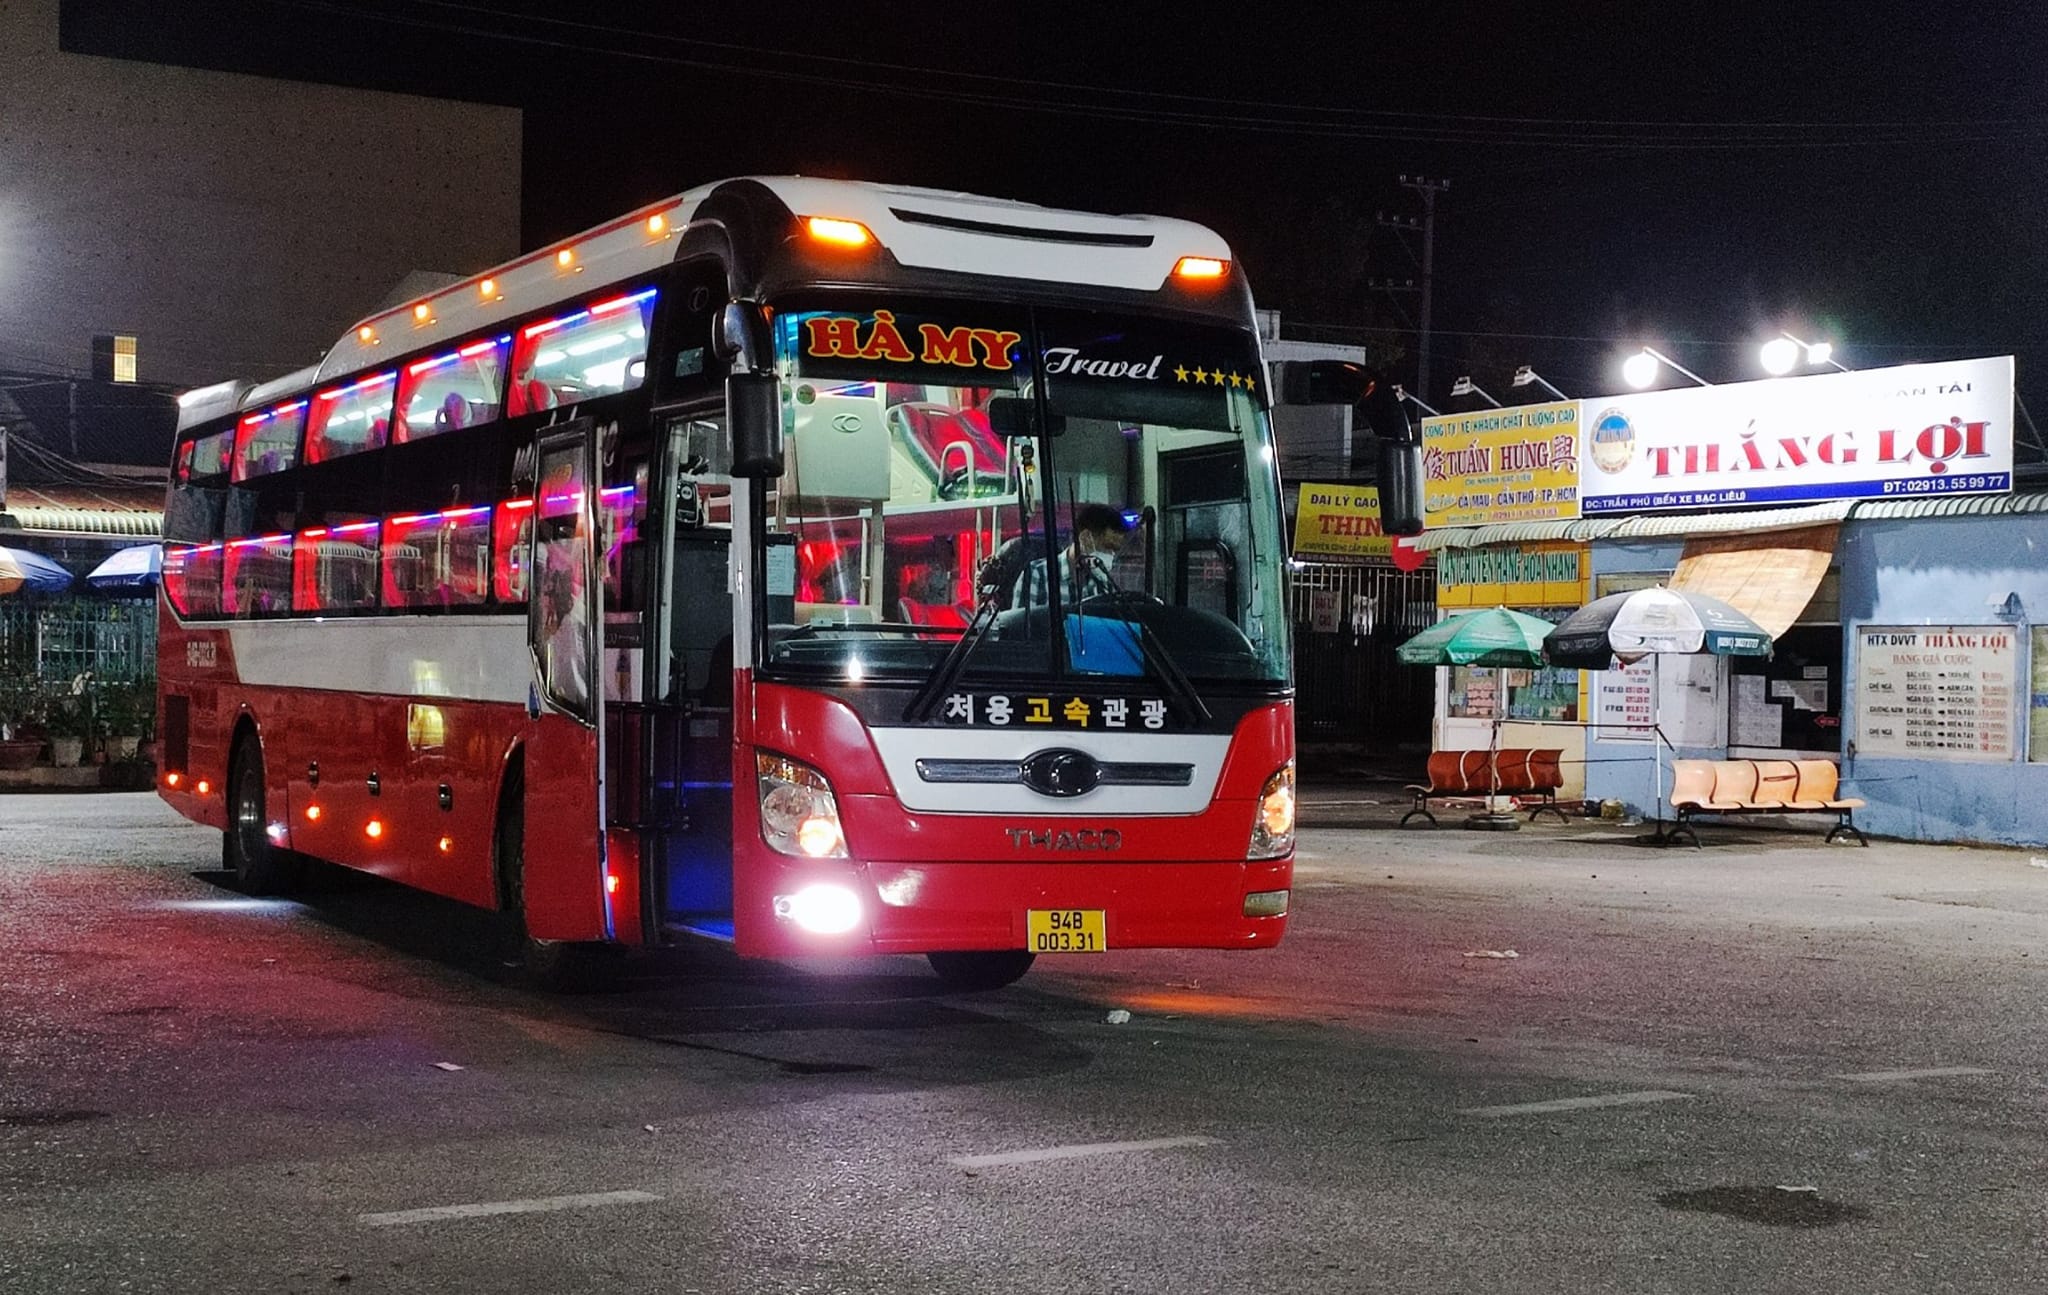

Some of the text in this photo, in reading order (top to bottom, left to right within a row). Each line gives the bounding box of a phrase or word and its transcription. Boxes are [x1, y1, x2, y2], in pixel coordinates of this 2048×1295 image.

[807, 310, 1021, 370] HÀ MY
[1043, 348, 1163, 381] Travel
[1557, 408, 1575, 423] CAO
[1447, 439, 1491, 475] TUẤN
[1501, 440, 1549, 470] HƯNG
[1646, 418, 1859, 479] THẮNG
[1877, 415, 1991, 475] LỢI
[1679, 495, 1694, 505] XE
[1696, 493, 1717, 505] BẠC
[1318, 514, 1384, 541] THỊN
[1544, 551, 1578, 582] NHANH
[1868, 635, 1888, 646] HTX
[1925, 627, 1976, 648] THẮNG
[1981, 632, 2009, 654] LỢI
[1005, 828, 1122, 851] THACO
[1050, 911, 1083, 930] 94B
[1037, 932, 1094, 950] 003.31
